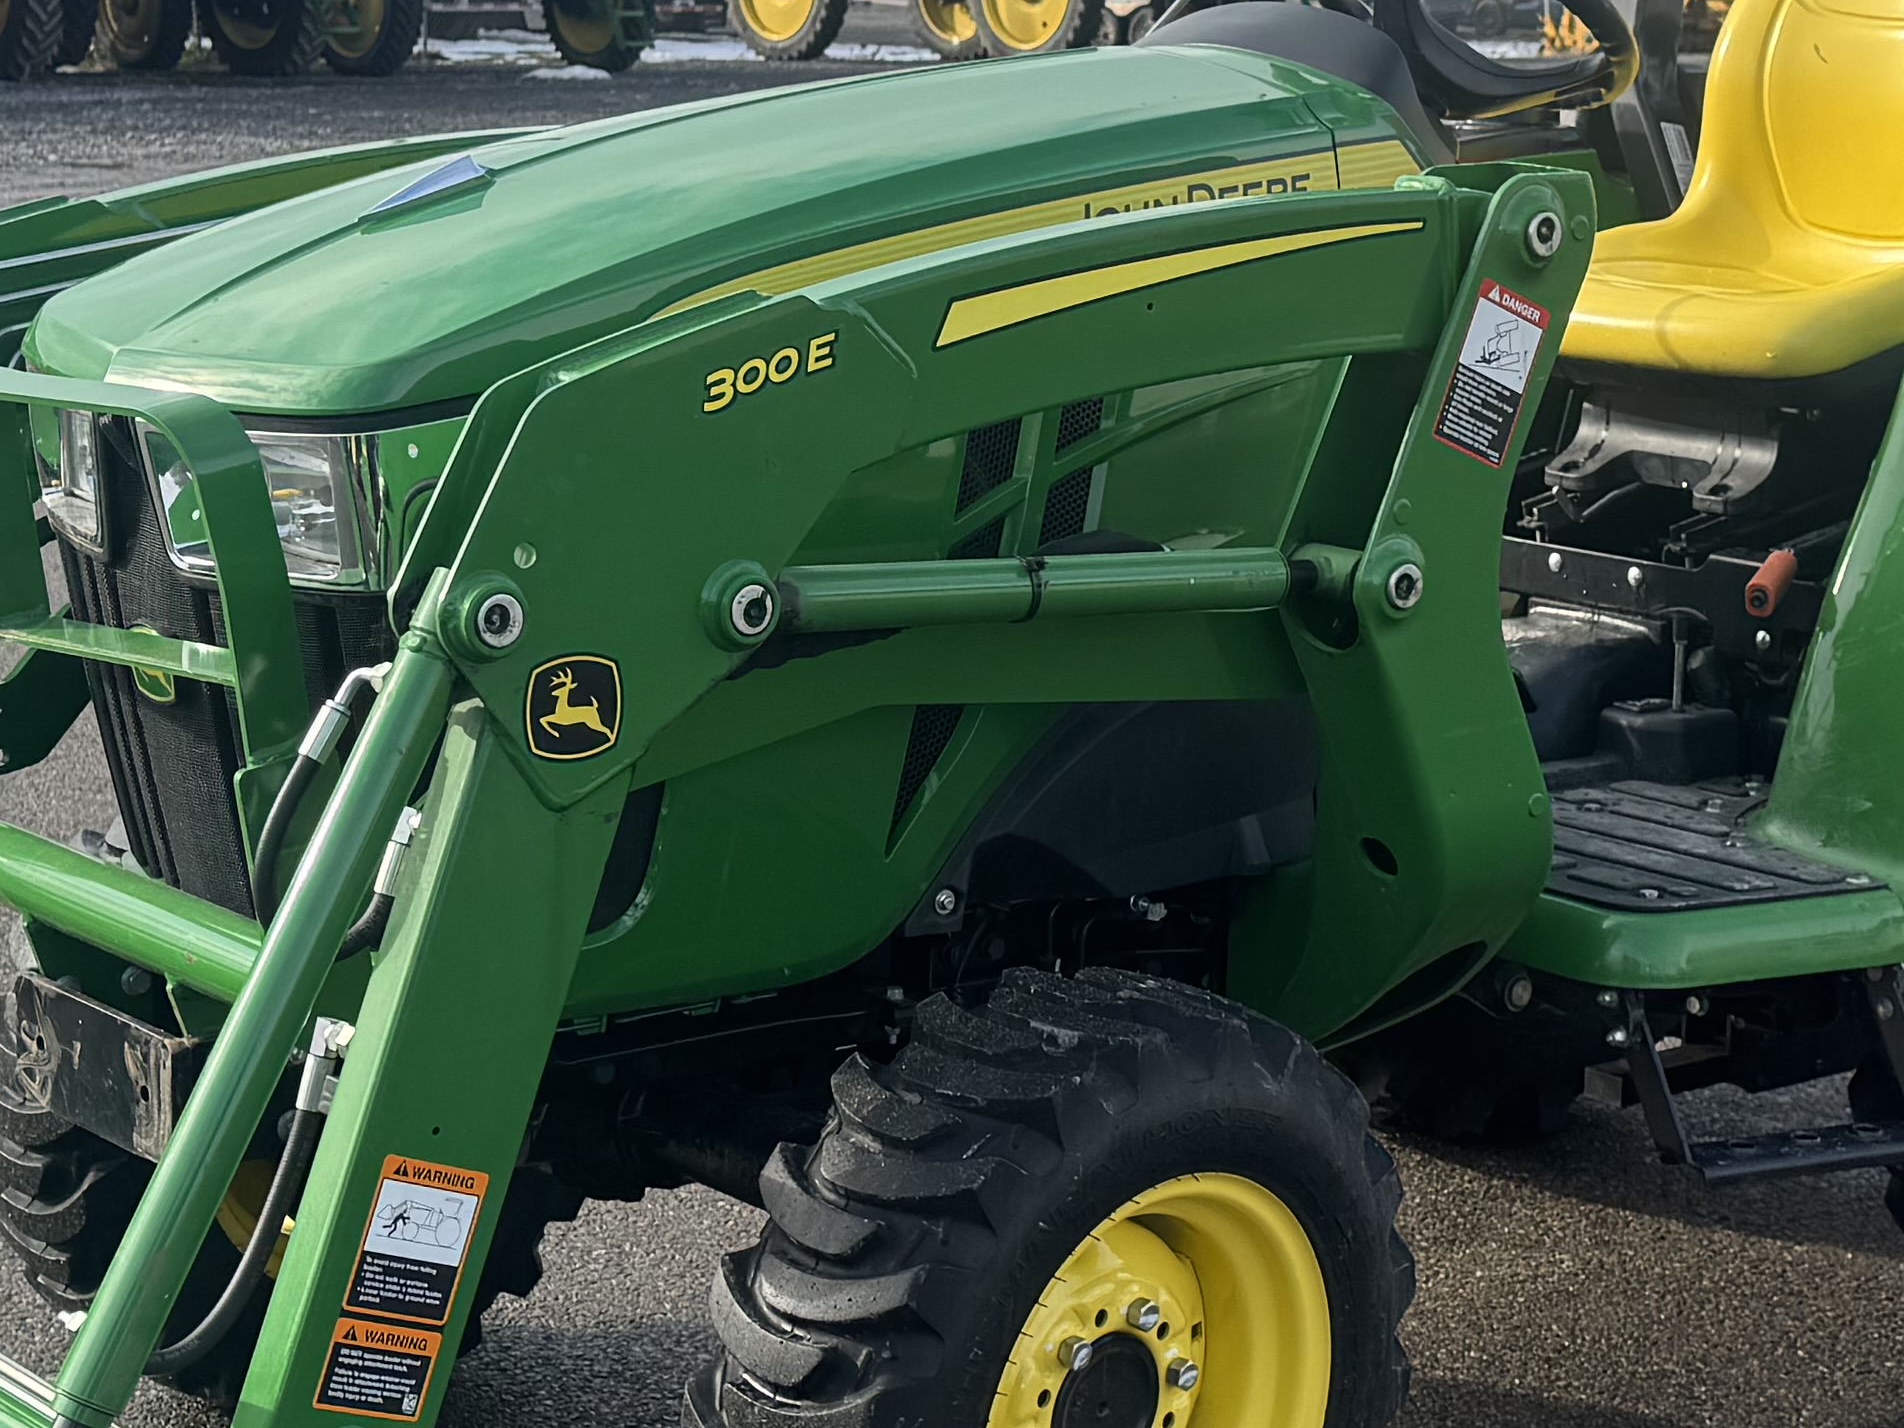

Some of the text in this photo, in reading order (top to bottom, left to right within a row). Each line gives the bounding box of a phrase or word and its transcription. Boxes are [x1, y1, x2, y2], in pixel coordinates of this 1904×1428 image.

[1501, 293, 1541, 322] DANGER
[702, 346, 800, 414] 300
[412, 1165, 475, 1189] WARNING
[364, 1329, 428, 1351] WARNING
